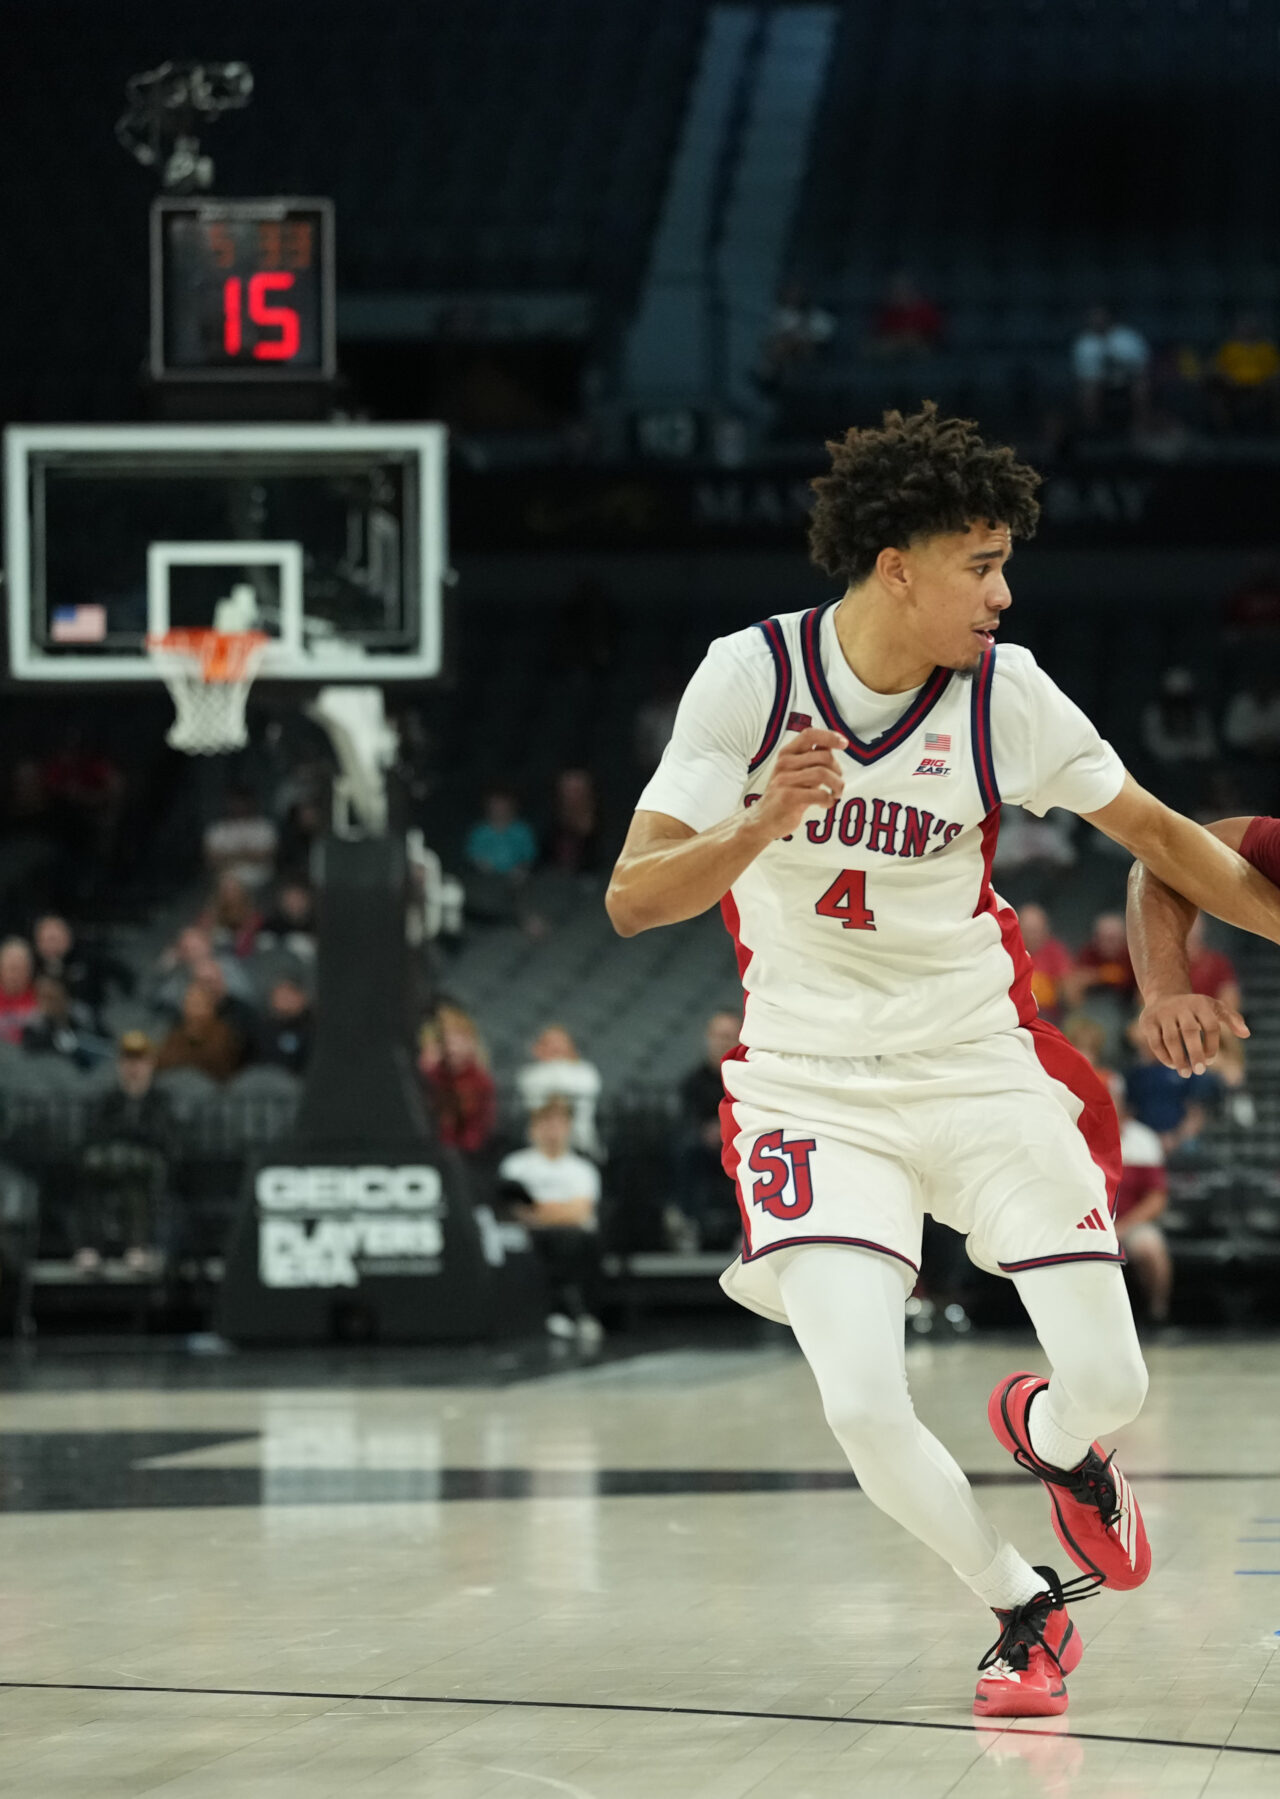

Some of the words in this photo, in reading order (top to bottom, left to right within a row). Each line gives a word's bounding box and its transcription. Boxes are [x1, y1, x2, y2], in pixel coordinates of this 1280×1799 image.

[223, 271, 301, 362] 15
[915, 766, 951, 775] EAST
[920, 758, 946, 767] BIG
[805, 797, 964, 858] JOHN'S
[815, 868, 877, 931] 4
[256, 1164, 443, 1211] GEICO
[748, 1128, 817, 1221] SJ
